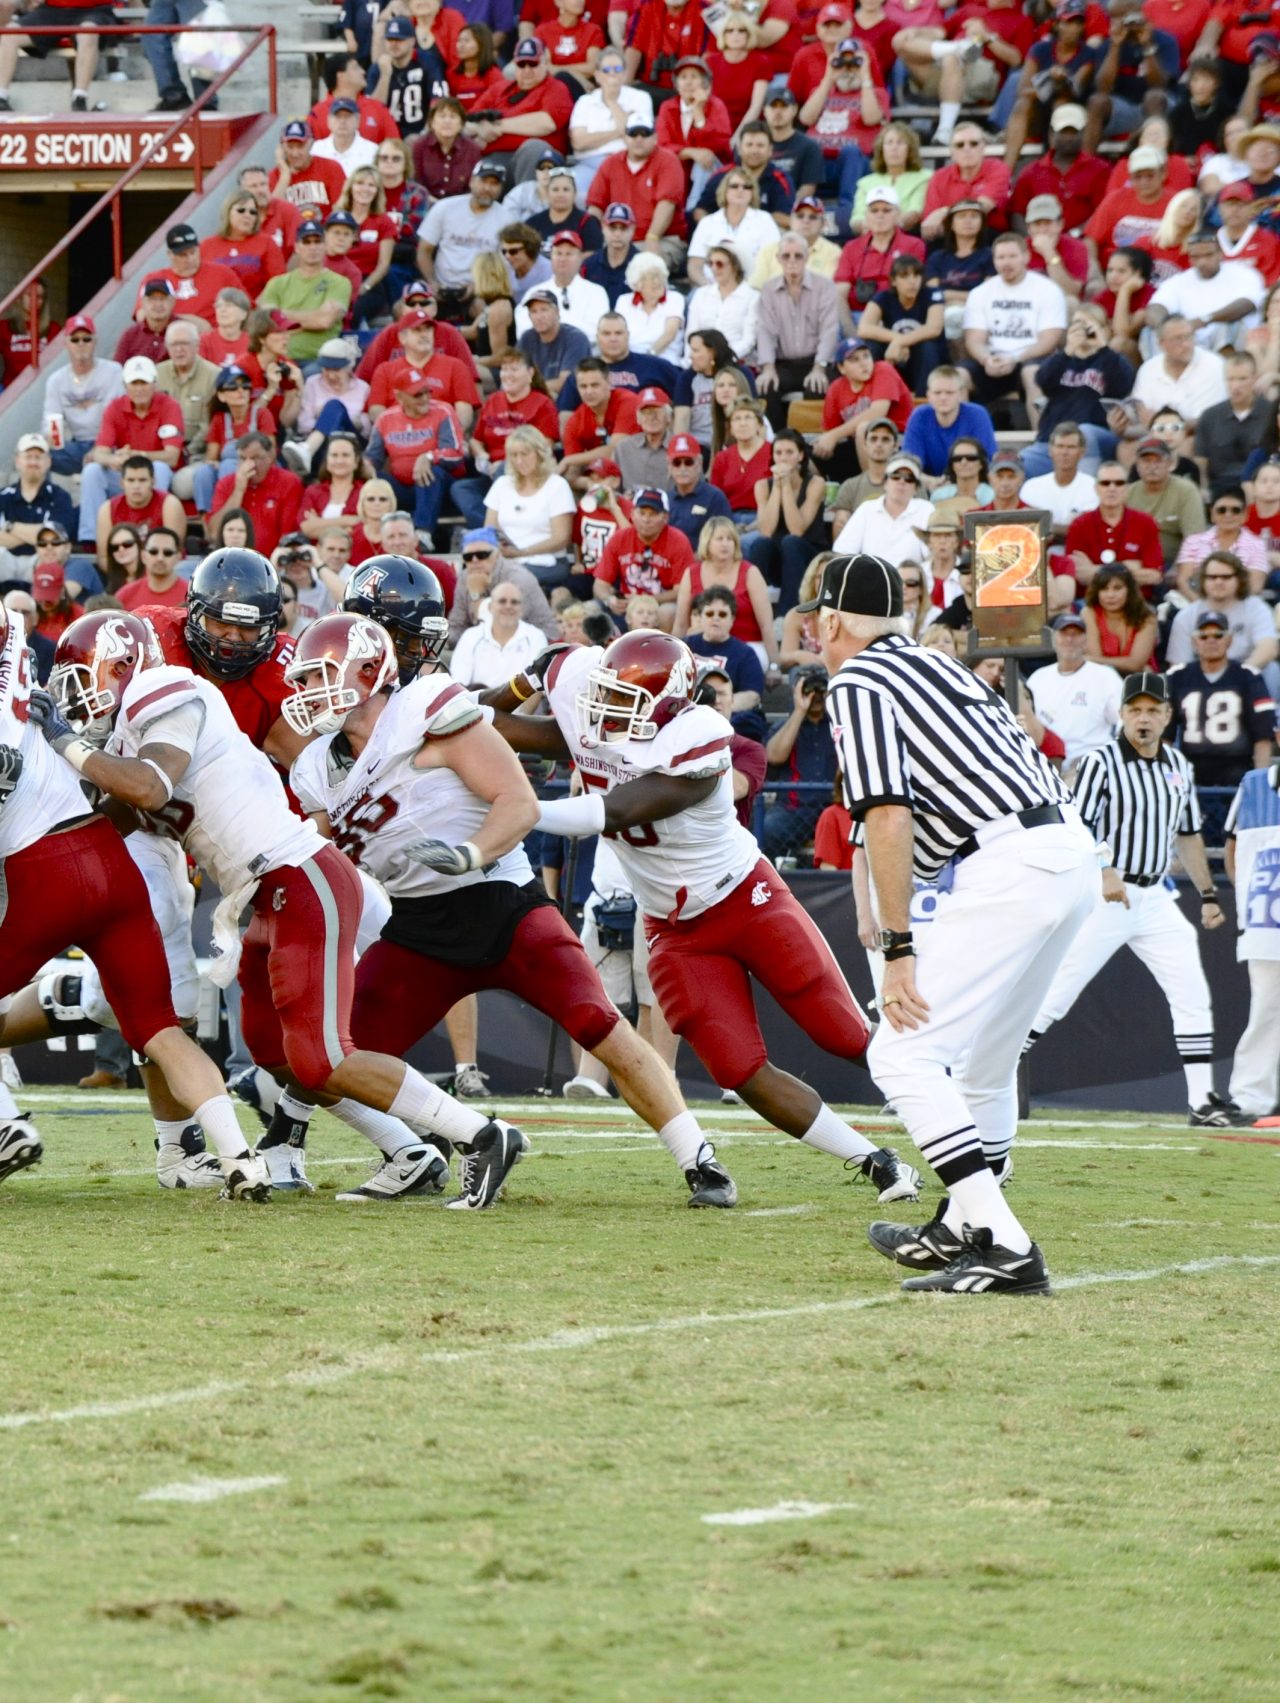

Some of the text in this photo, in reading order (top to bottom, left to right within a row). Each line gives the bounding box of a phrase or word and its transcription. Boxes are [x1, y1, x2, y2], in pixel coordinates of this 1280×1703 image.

[390, 69, 424, 123] 48
[0, 134, 27, 164] 22
[34, 133, 132, 164] SECTION
[355, 565, 389, 600] A
[976, 524, 1042, 608] 2
[1181, 690, 1244, 744] 18
[573, 752, 618, 777] WASHINGTON
